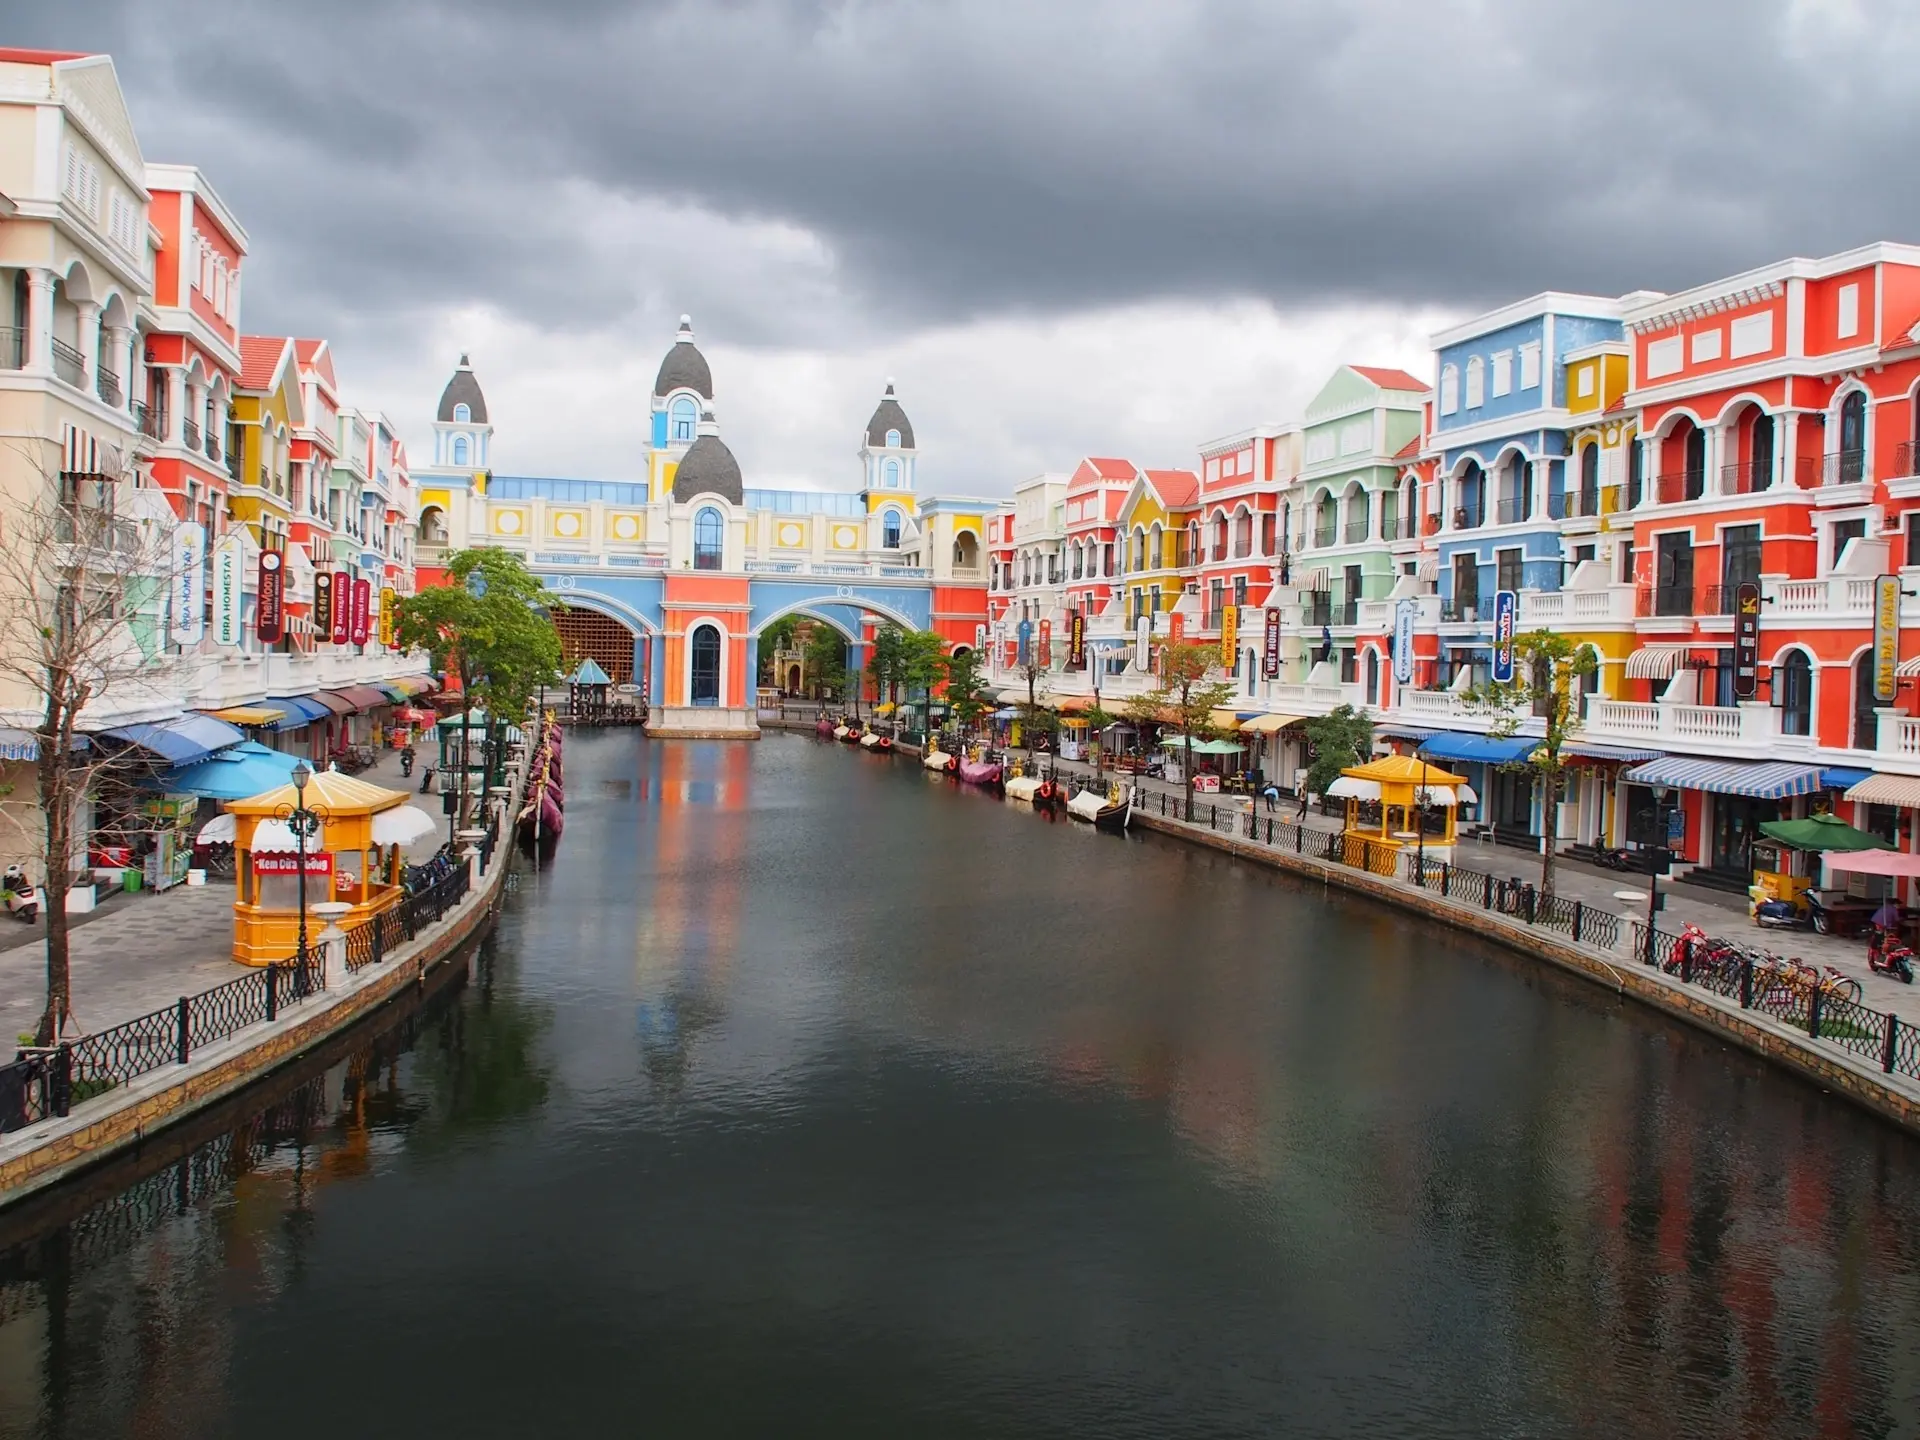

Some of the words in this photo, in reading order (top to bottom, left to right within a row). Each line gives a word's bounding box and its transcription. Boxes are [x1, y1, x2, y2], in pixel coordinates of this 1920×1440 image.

[183, 551, 192, 603] HOMETAY
[223, 554, 232, 611] HOMESTAY
[222, 614, 231, 642] ERRA
[258, 858, 278, 870] Kem
